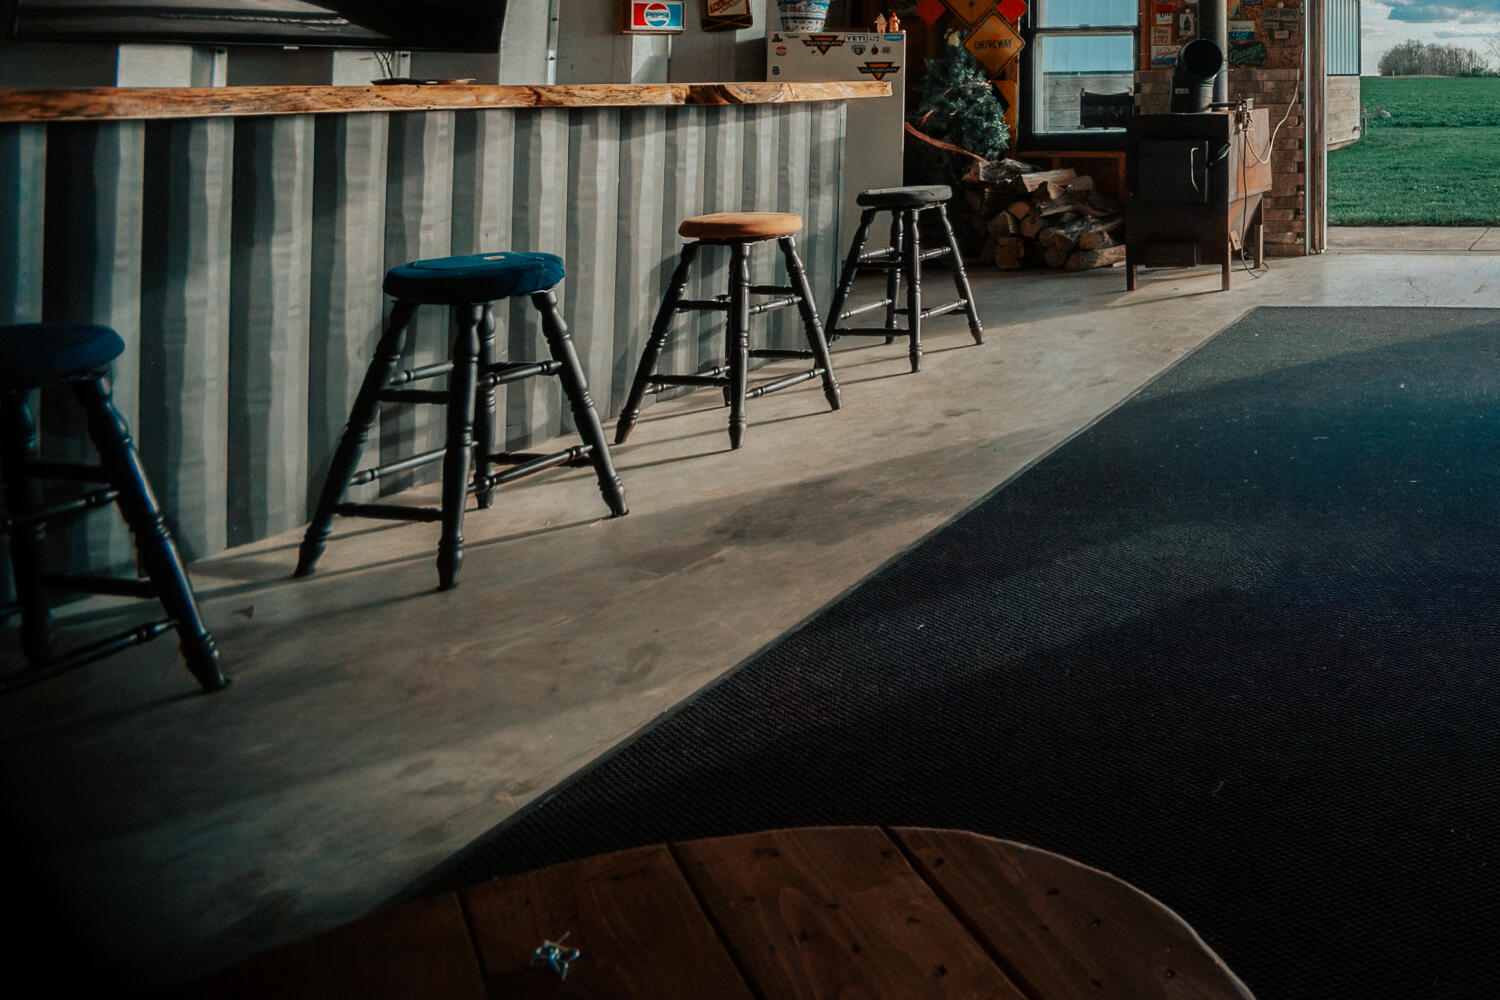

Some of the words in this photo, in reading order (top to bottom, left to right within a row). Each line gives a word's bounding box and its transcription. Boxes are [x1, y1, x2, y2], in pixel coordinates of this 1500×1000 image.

[645, 10, 670, 19] PEPSI
[846, 34, 867, 42] YETI
[974, 38, 1012, 50] DRIVEWAY
